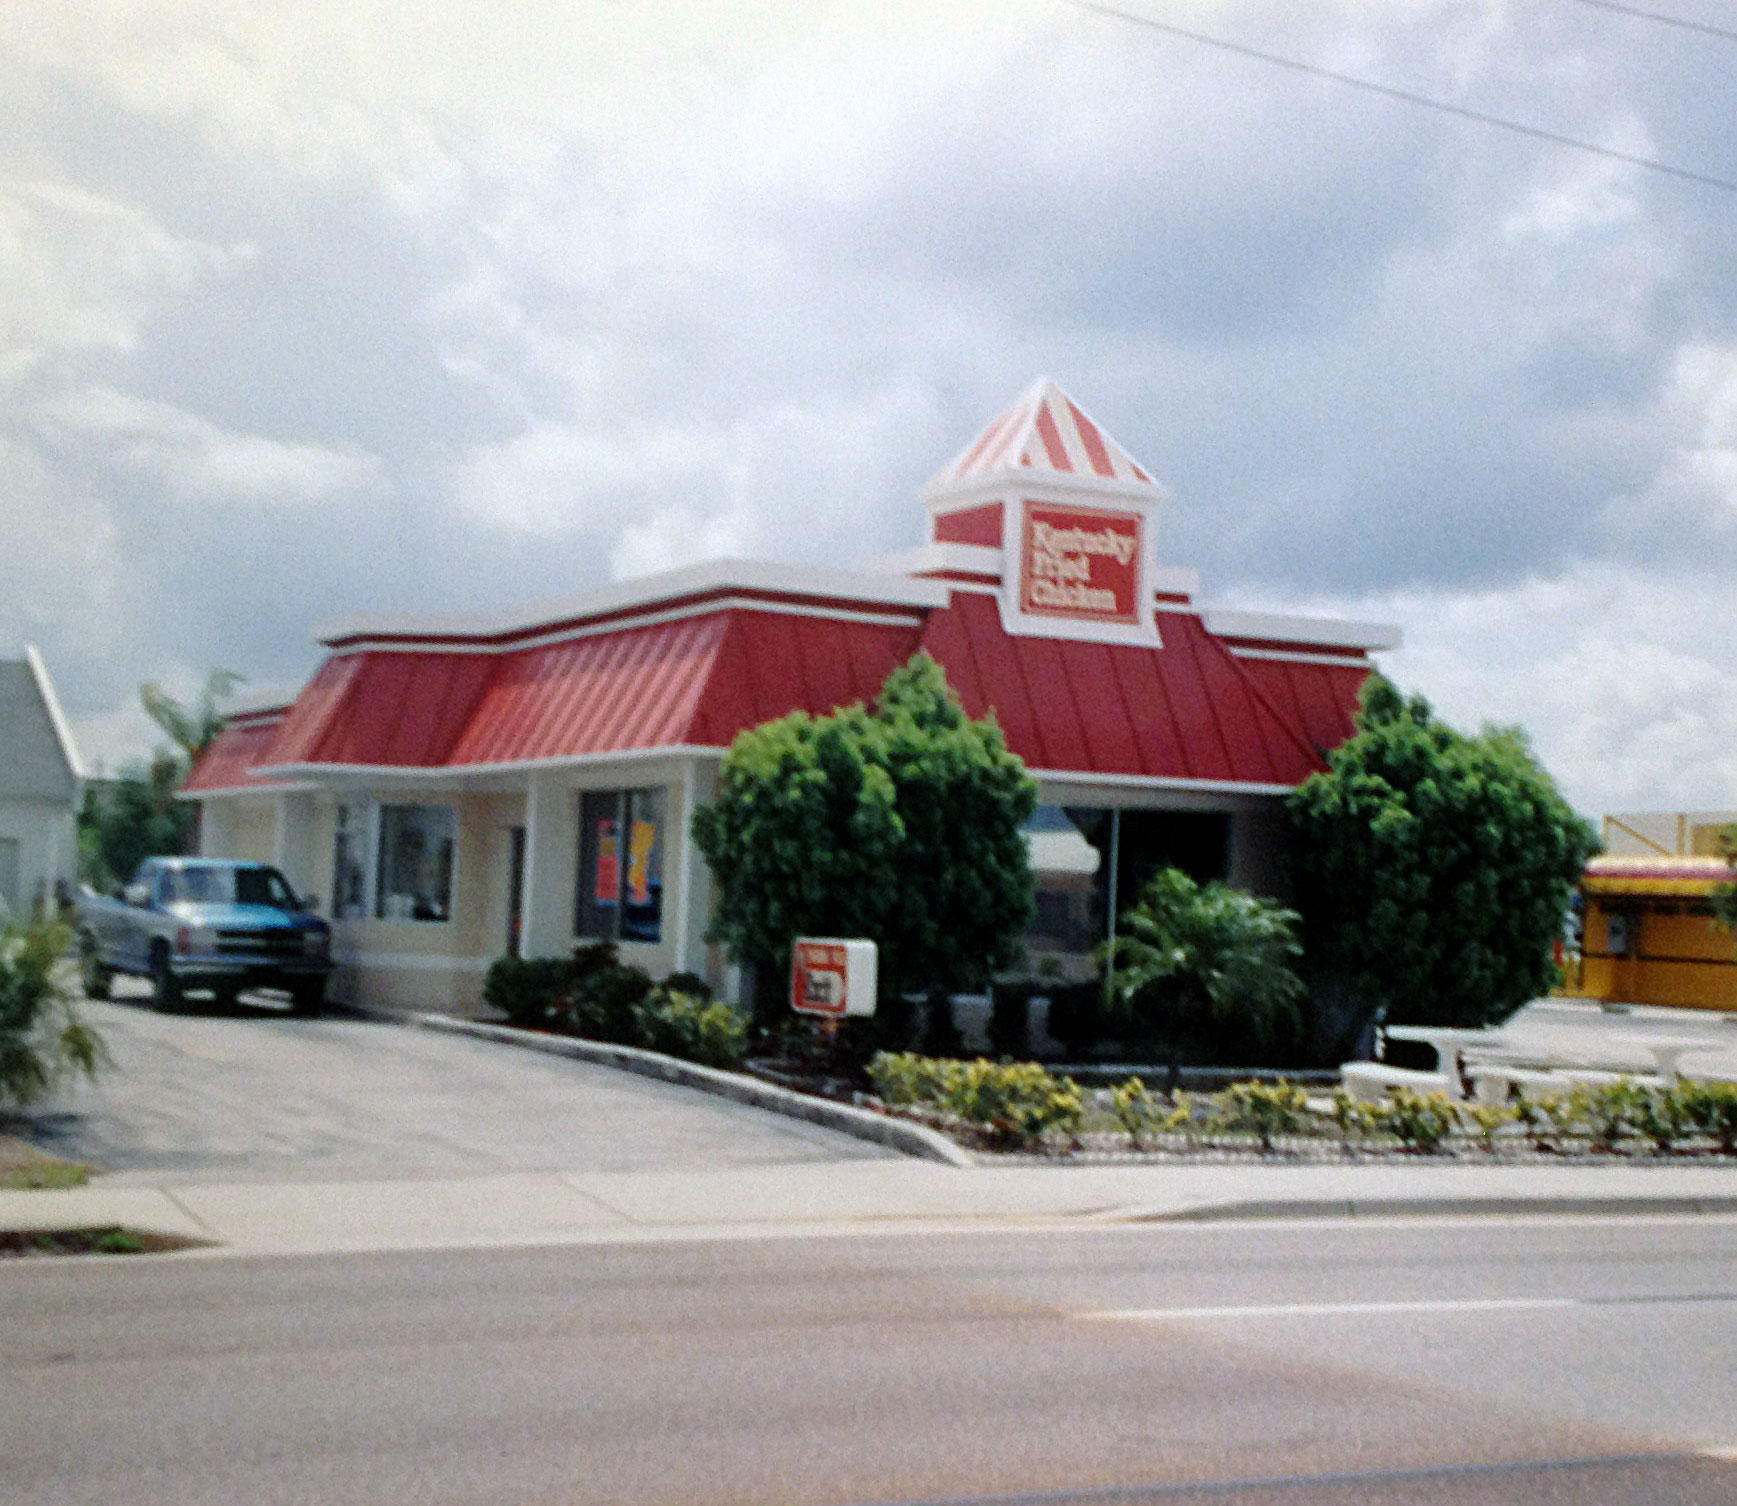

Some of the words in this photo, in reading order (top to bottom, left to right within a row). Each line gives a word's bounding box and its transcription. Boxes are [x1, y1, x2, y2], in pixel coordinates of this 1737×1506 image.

[1032, 521, 1137, 565] Kentucky
[1033, 551, 1091, 582] Fried
[1031, 580, 1118, 611] Chicken
